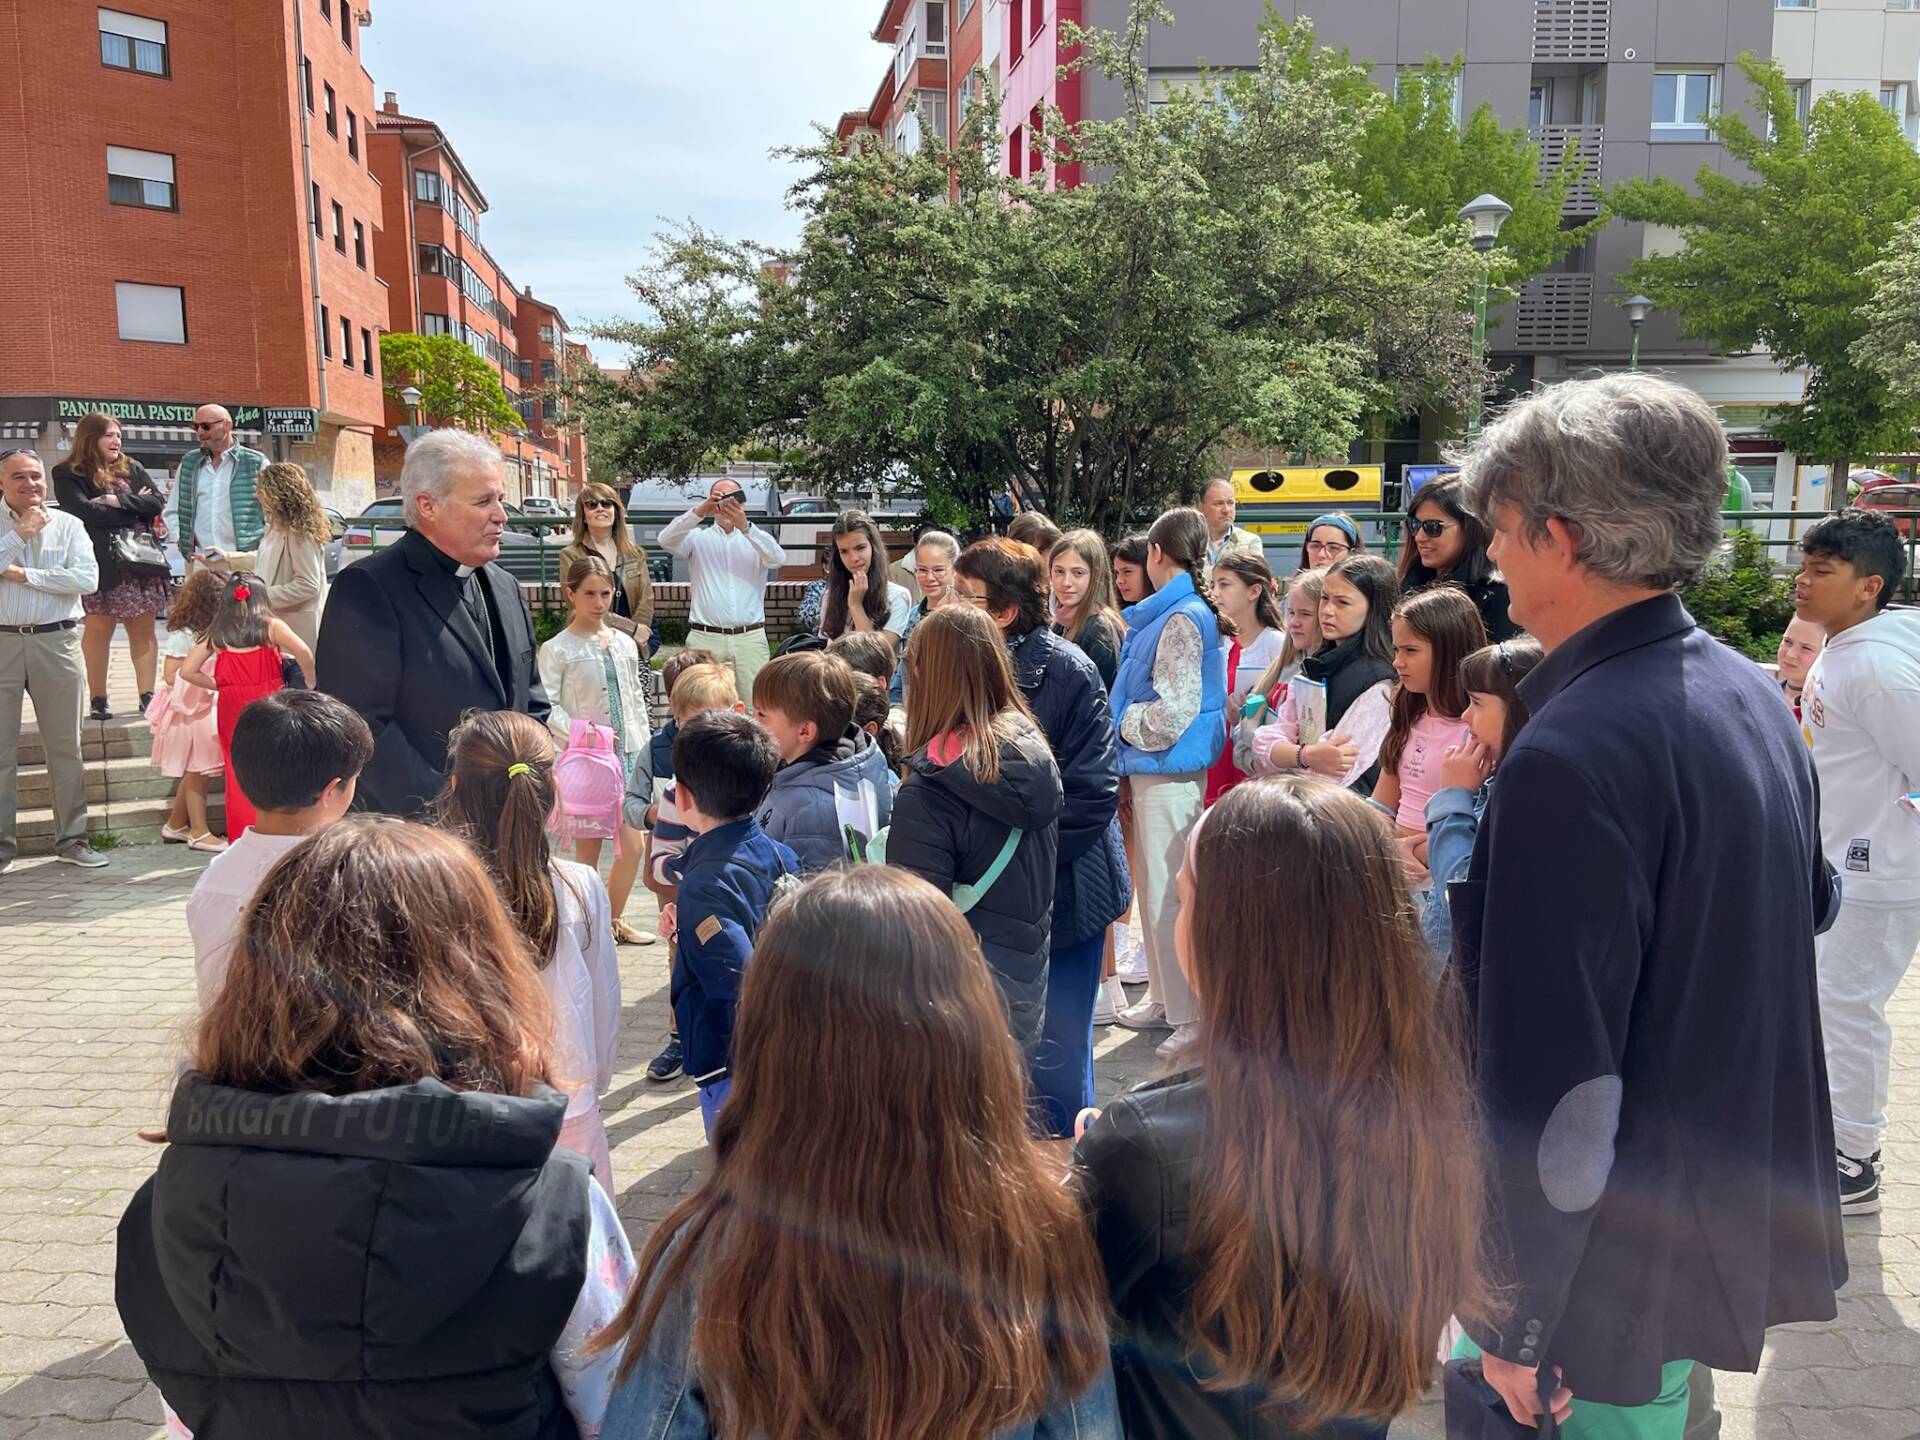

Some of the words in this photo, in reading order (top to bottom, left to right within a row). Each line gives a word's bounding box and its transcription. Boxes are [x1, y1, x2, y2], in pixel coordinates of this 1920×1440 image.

[58, 400, 145, 420] PANADERIA
[234, 405, 260, 427] Ana
[267, 410, 311, 420] PANADERIA
[267, 423, 312, 433] PASTELERIA
[186, 1093, 323, 1137] BRIGHT
[333, 1093, 512, 1148] FUTURE
